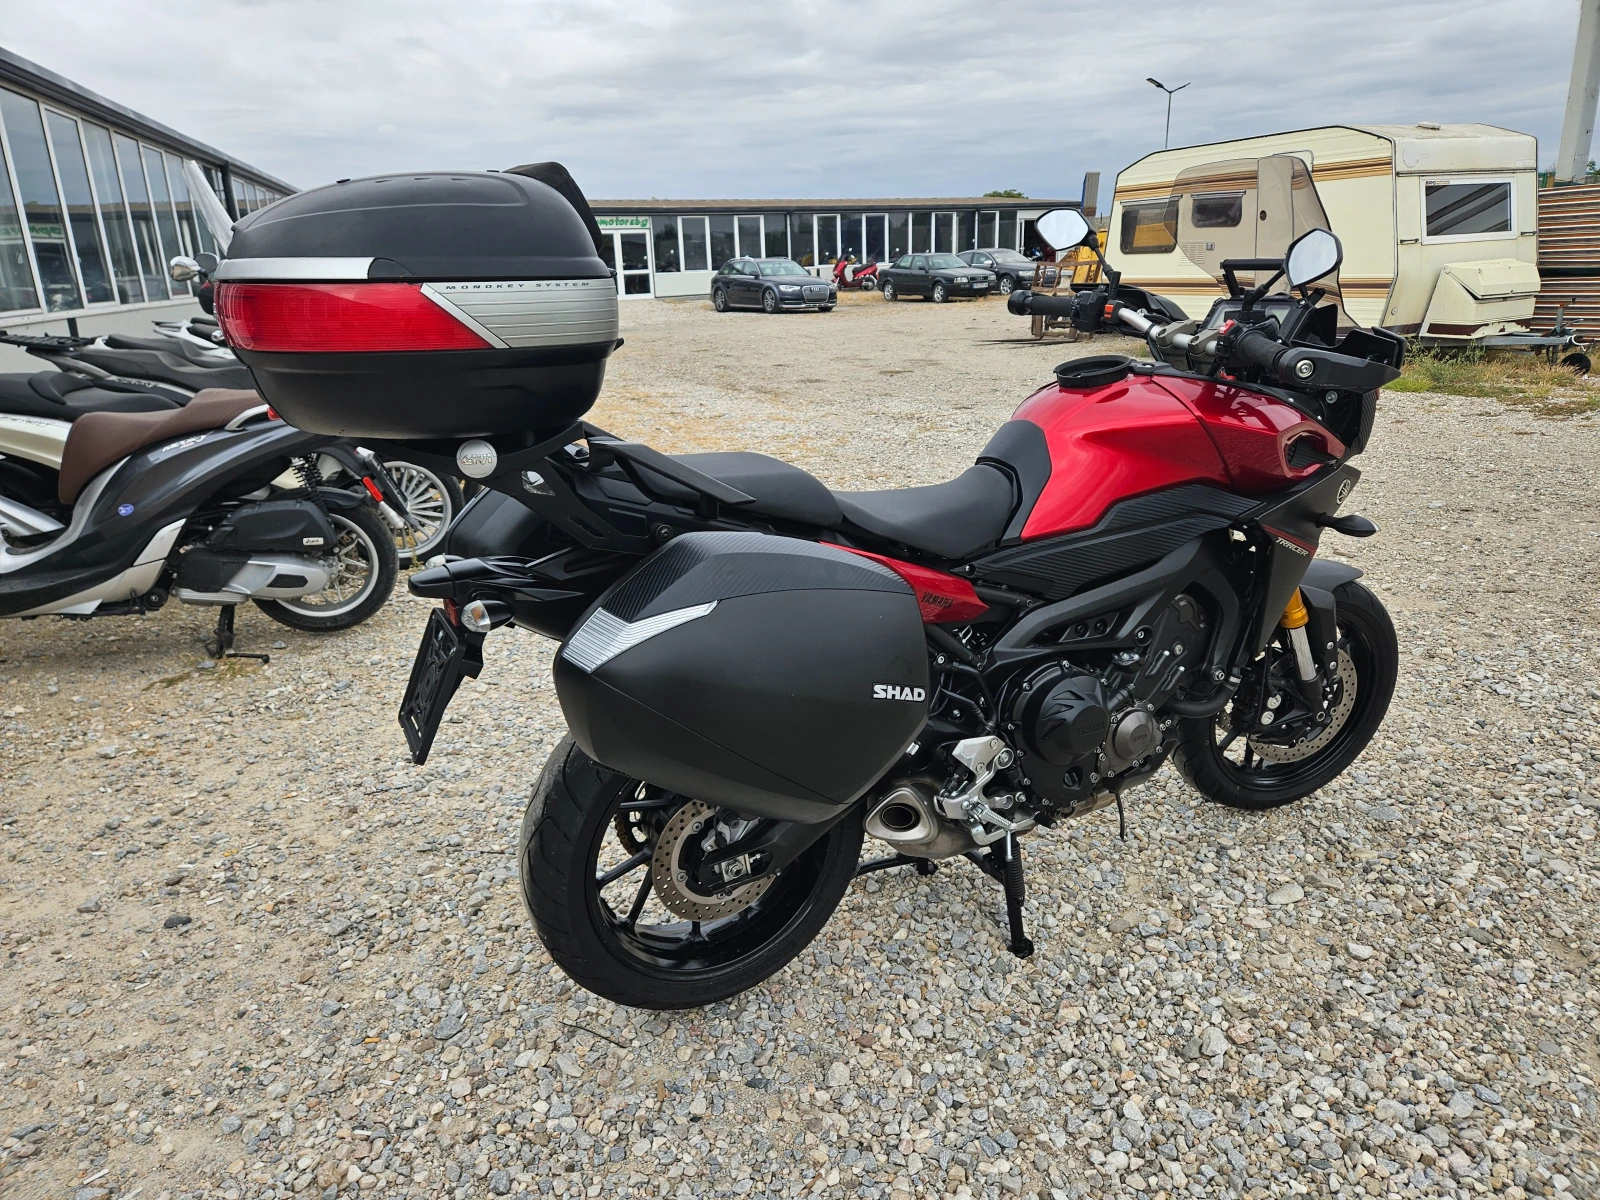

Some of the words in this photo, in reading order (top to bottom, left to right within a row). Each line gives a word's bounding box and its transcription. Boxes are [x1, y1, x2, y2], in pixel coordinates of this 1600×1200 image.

[596, 216, 649, 228] motorsbg
[1276, 536, 1310, 557] TRACER
[921, 592, 954, 610] YAMAHA
[873, 684, 926, 702] SHAD
